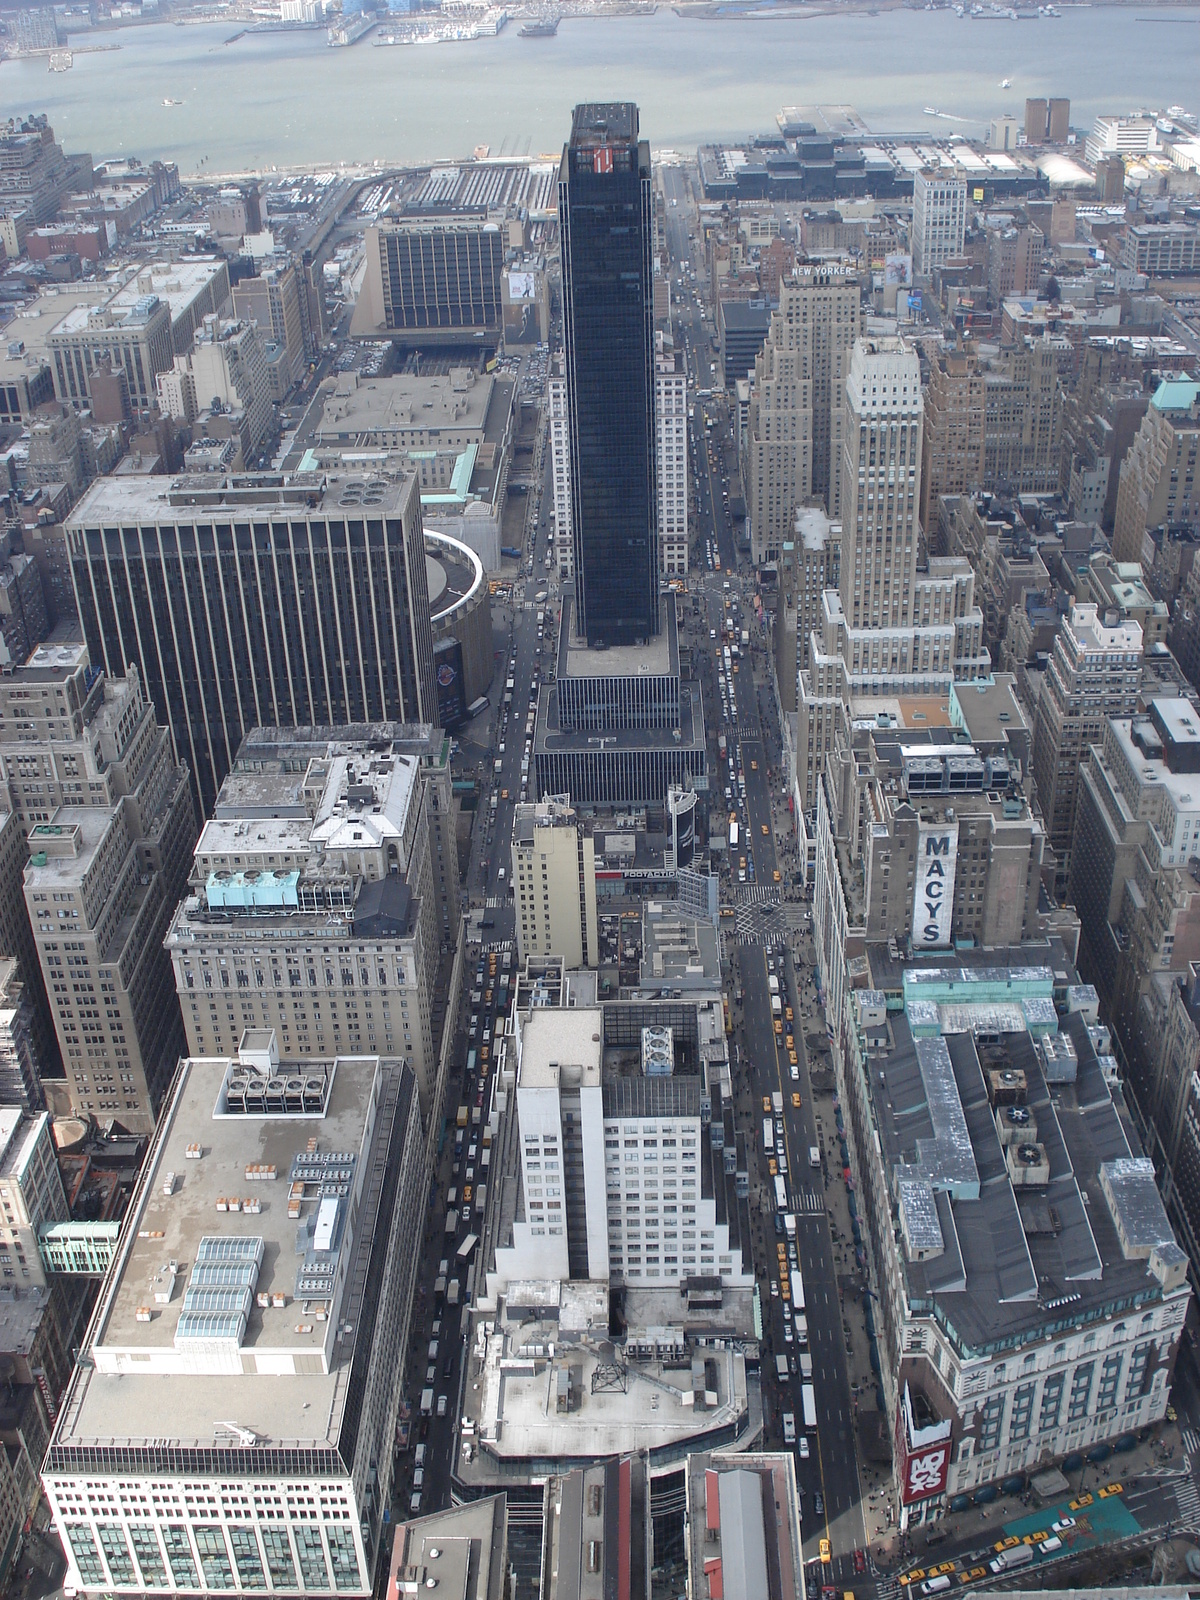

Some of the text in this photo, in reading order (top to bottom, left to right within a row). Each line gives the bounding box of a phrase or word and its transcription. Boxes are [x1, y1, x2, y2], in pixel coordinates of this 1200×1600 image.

[792, 267, 851, 277] NEW YORKER
[923, 837, 950, 941] MACYS
